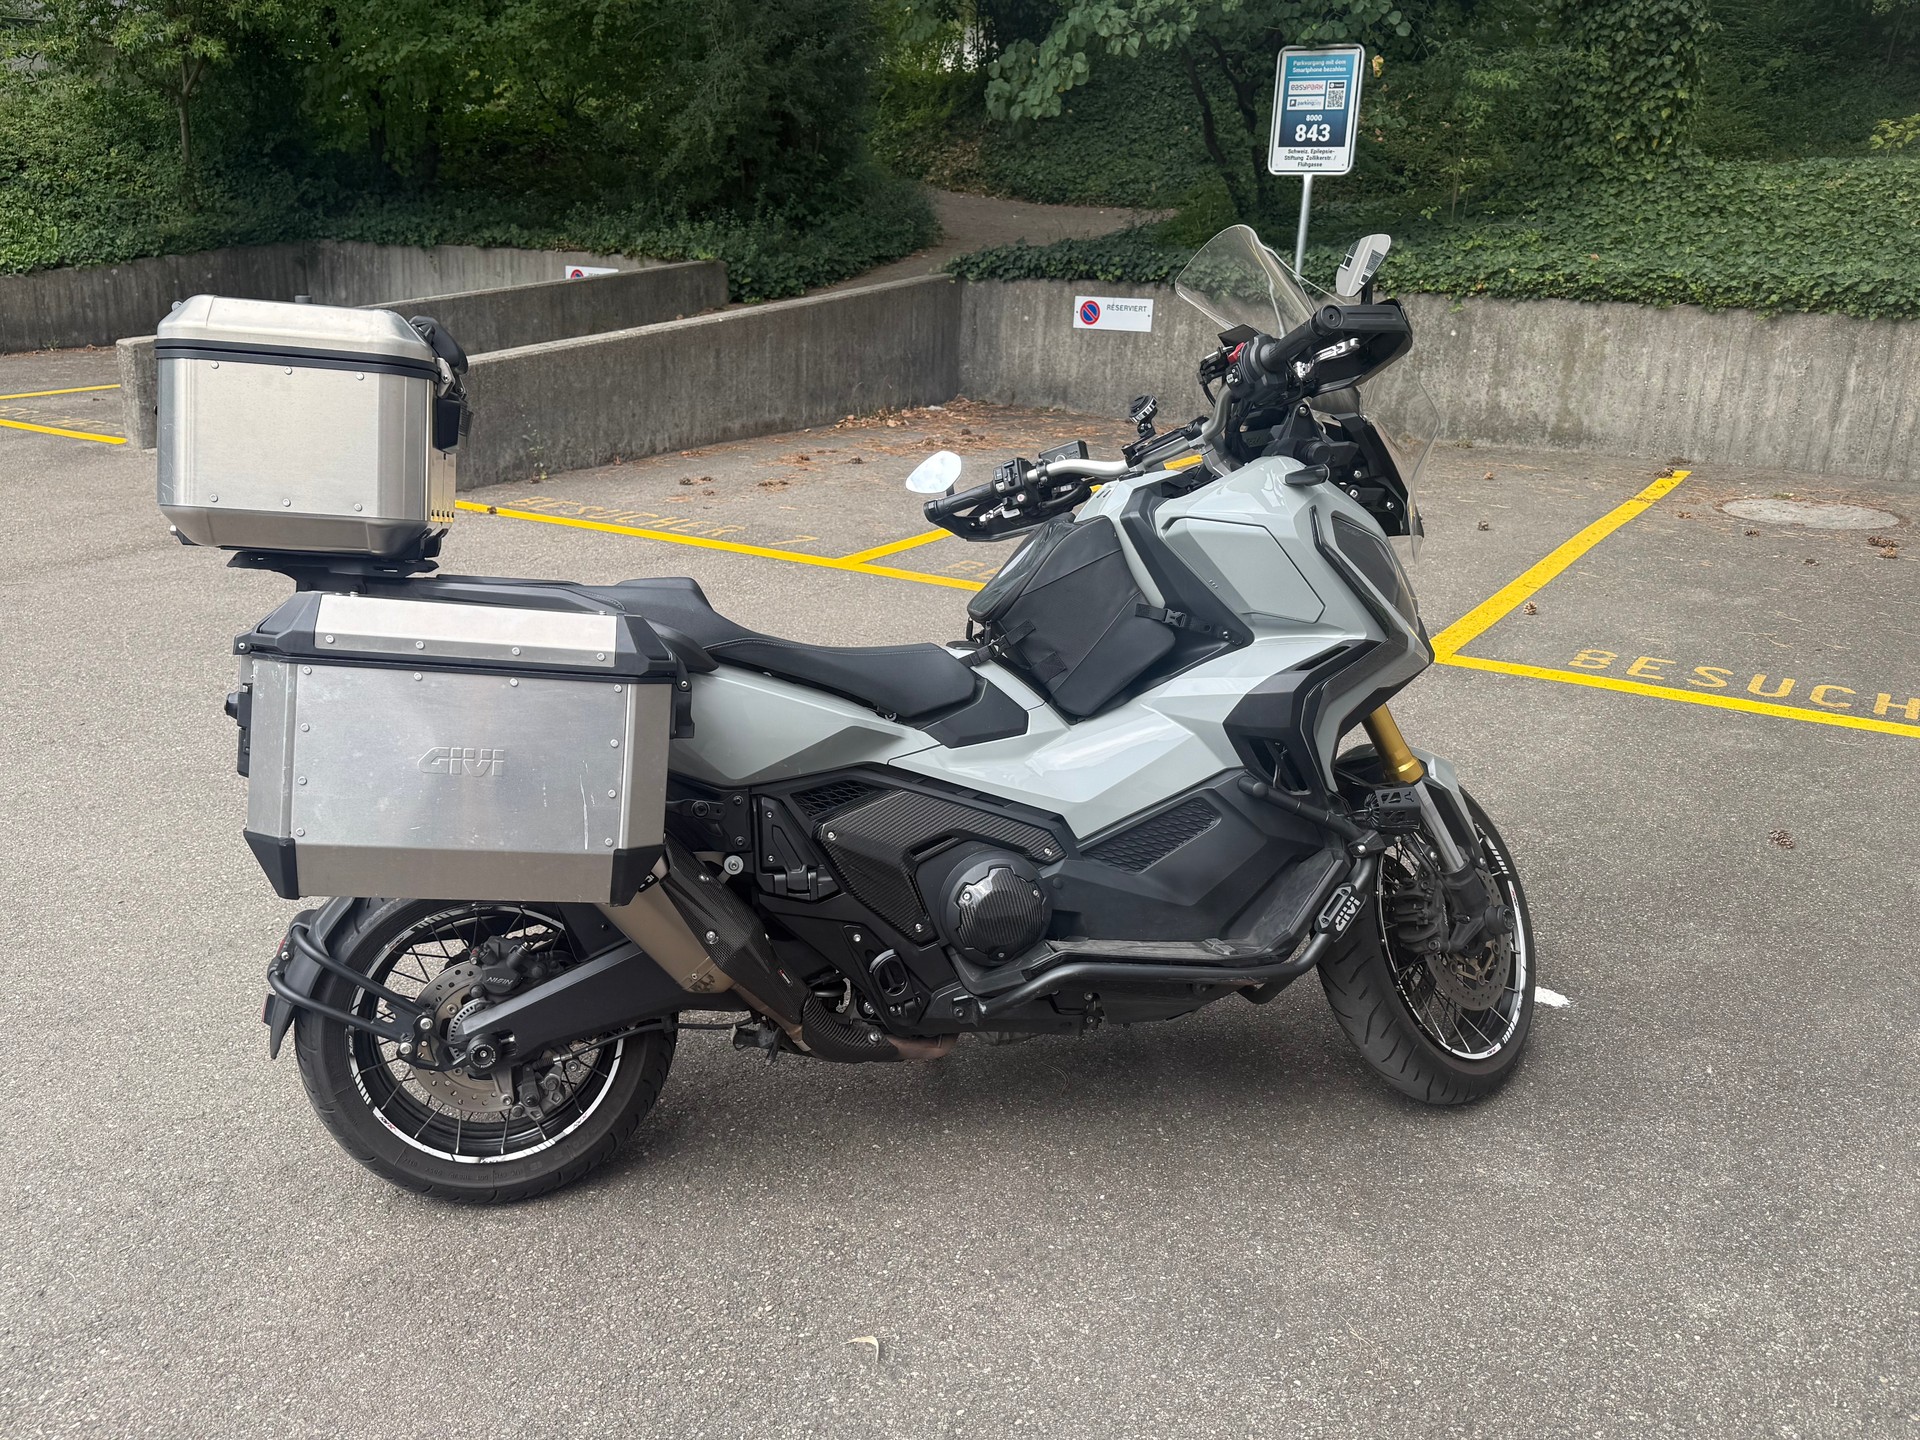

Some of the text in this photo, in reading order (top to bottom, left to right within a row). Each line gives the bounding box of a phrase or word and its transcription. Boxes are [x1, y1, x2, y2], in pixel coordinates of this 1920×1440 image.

[1294, 123, 1331, 142] 843
[1305, 114, 1322, 122] 8000
[1567, 648, 1920, 720] BESUCH
[417, 747, 504, 777] GIVI
[1335, 896, 1361, 931] GIVI
